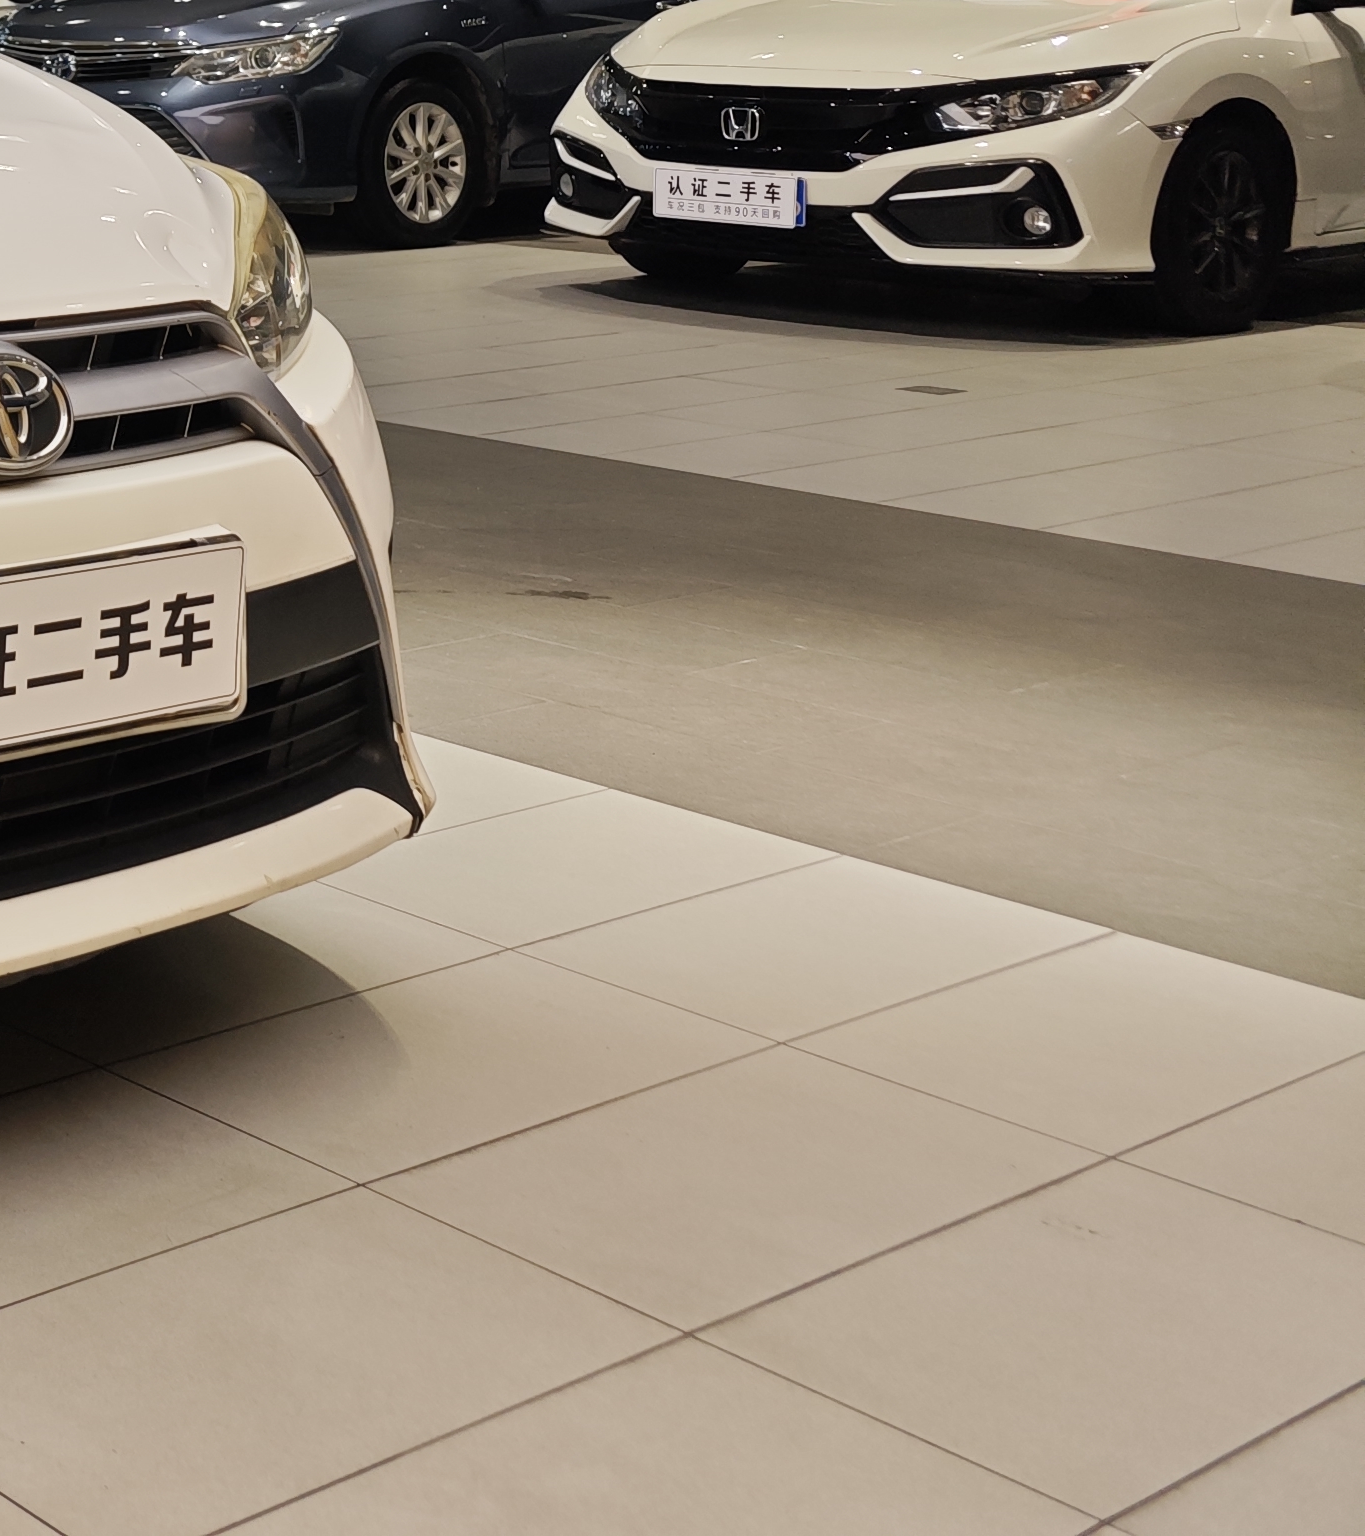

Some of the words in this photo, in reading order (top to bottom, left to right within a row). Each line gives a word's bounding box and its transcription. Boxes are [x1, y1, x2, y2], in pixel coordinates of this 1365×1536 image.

[667, 175, 782, 205] 认证二手车
[667, 201, 706, 214] 车况三包
[713, 205, 781, 220] 支持90天回购
